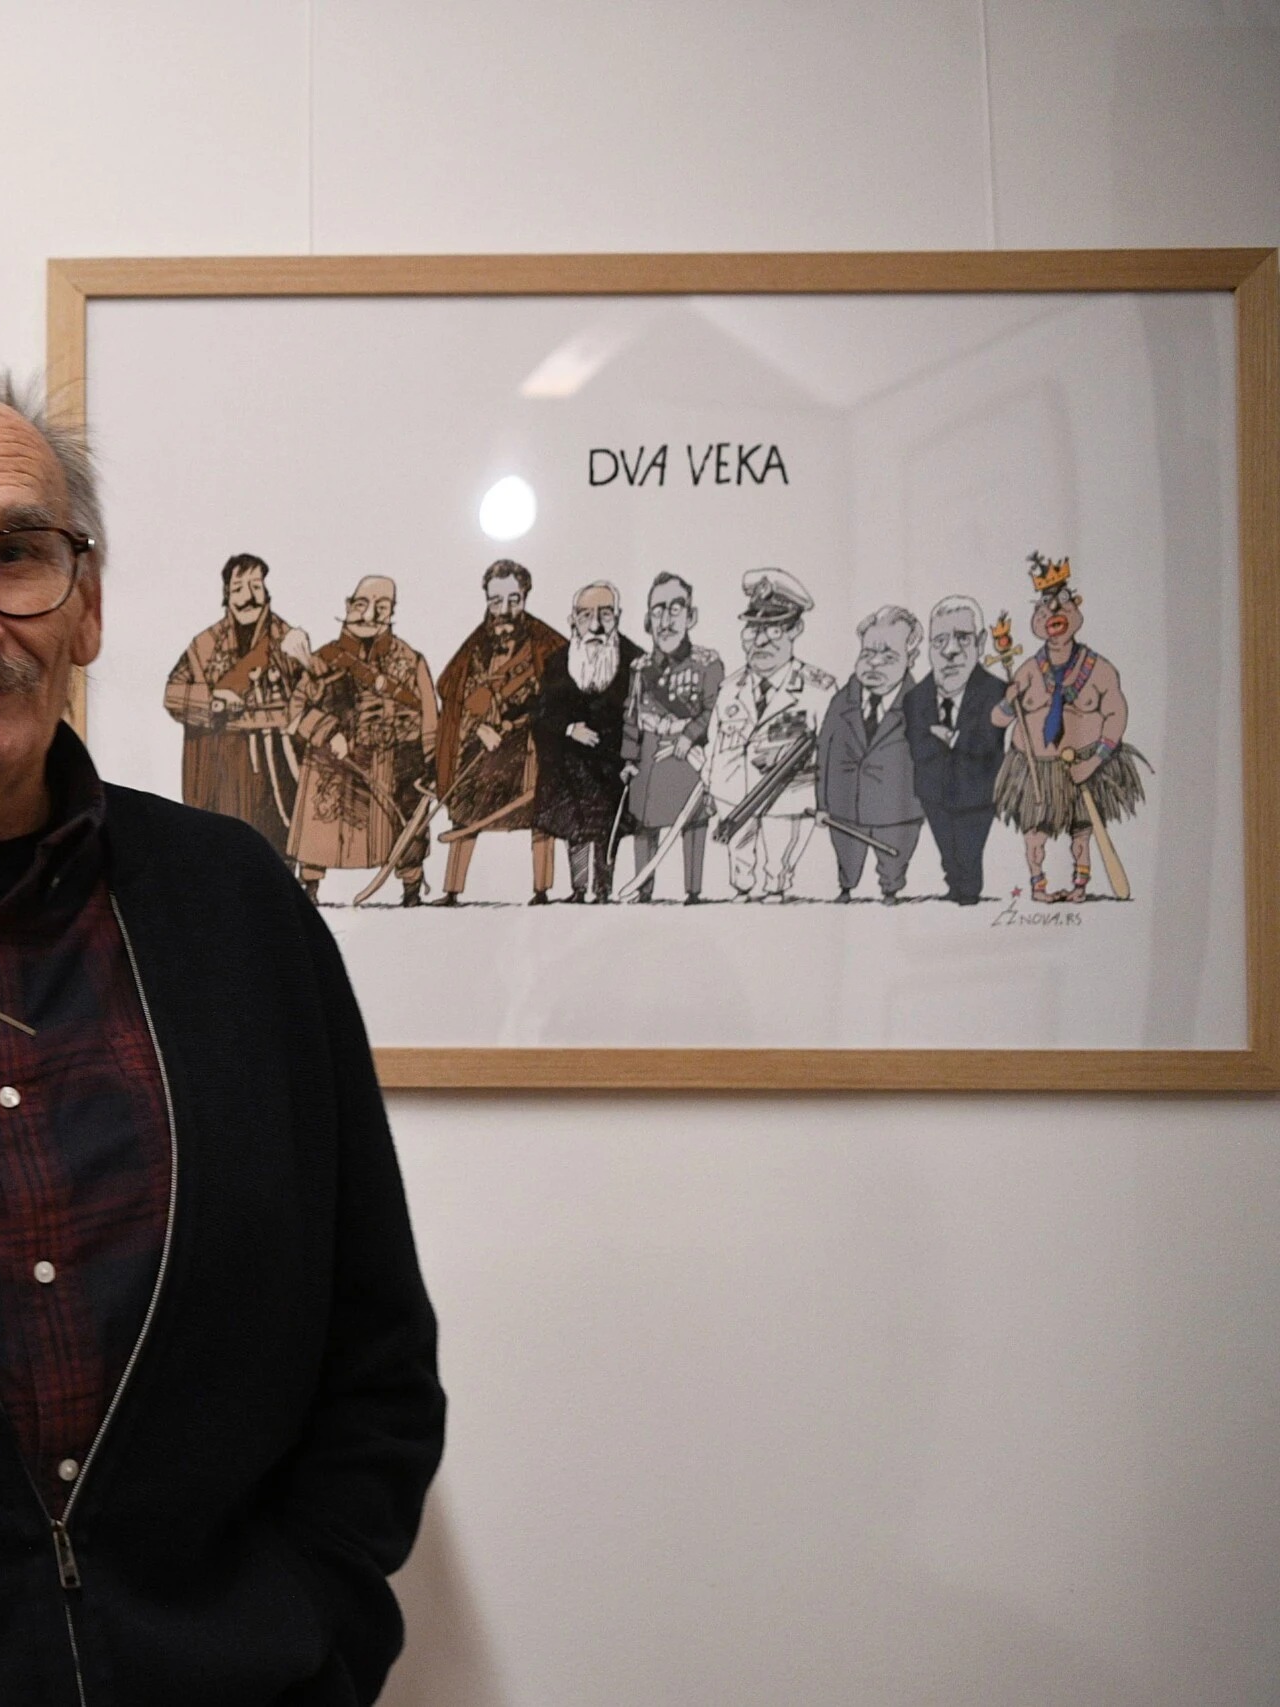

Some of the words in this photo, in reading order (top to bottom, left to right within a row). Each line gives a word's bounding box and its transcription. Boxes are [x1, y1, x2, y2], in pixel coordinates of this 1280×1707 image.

[589, 444, 668, 486] DVA
[687, 442, 789, 486] VEKA
[1020, 912, 1082, 926] NOVA.RS
